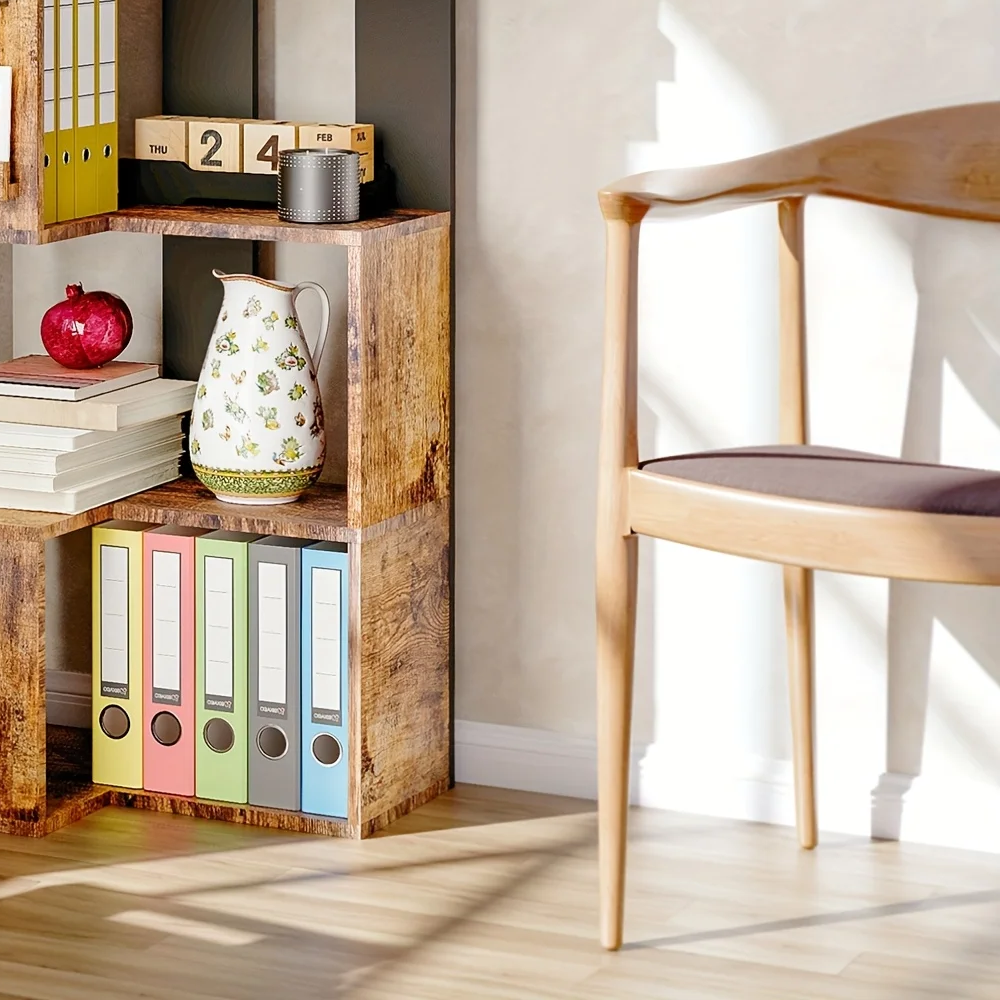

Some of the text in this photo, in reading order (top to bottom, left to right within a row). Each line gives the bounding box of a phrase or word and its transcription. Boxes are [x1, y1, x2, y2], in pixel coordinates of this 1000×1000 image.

[149, 129, 333, 171] THU 2 4 FEB
